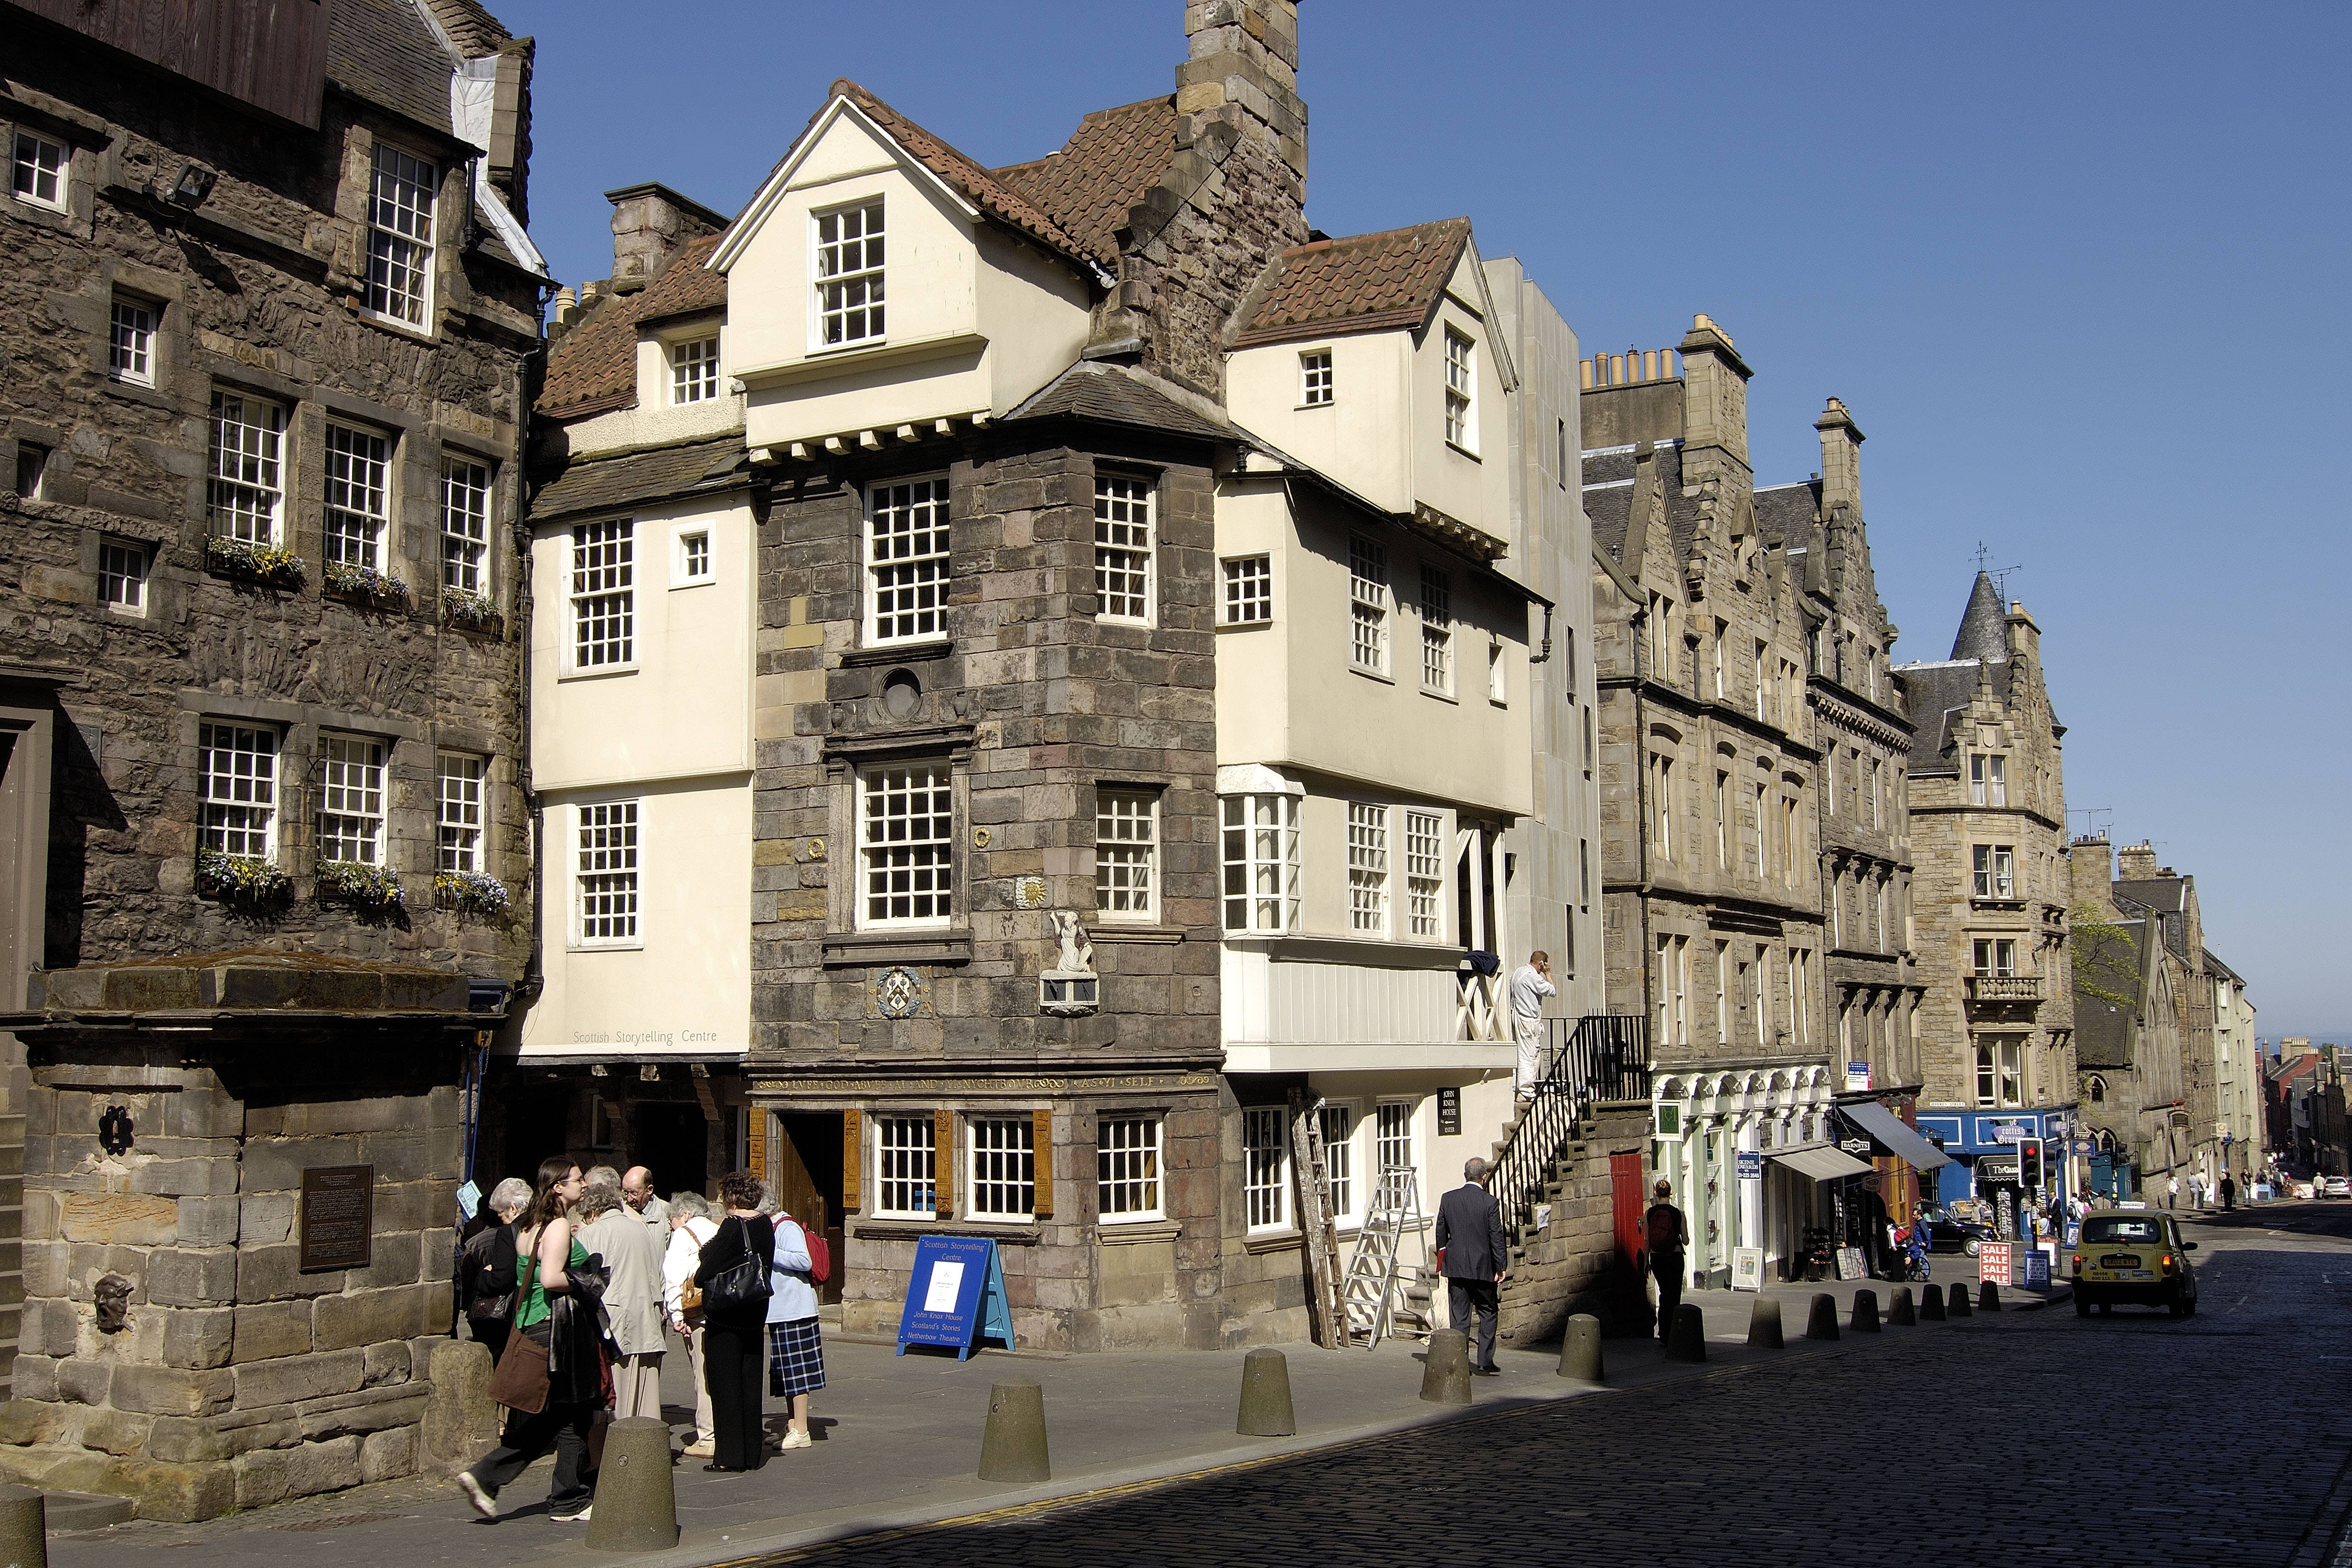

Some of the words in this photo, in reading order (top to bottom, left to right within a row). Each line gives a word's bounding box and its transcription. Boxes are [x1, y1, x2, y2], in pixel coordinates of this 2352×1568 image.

[573, 1031, 609, 1043] Scottish
[616, 1031, 673, 1046] Storytelling
[682, 1030, 717, 1042] Centre
[826, 1080, 848, 1090] GOD
[913, 1079, 937, 1090] AND
[1081, 1078, 1098, 1088] AS
[1125, 1077, 1155, 1086] SELF
[1443, 1090, 1454, 1099] JOHN
[924, 1241, 948, 1250] Scottish
[951, 1242, 984, 1252] Storytelling
[1982, 1245, 2007, 1254] SALE
[1983, 1255, 2008, 1264] SALE
[1983, 1265, 2008, 1274] SALE
[1983, 1275, 2008, 1284] SALE
[911, 1321, 939, 1330] Scotland's
[939, 1334, 960, 1342] Theatre
